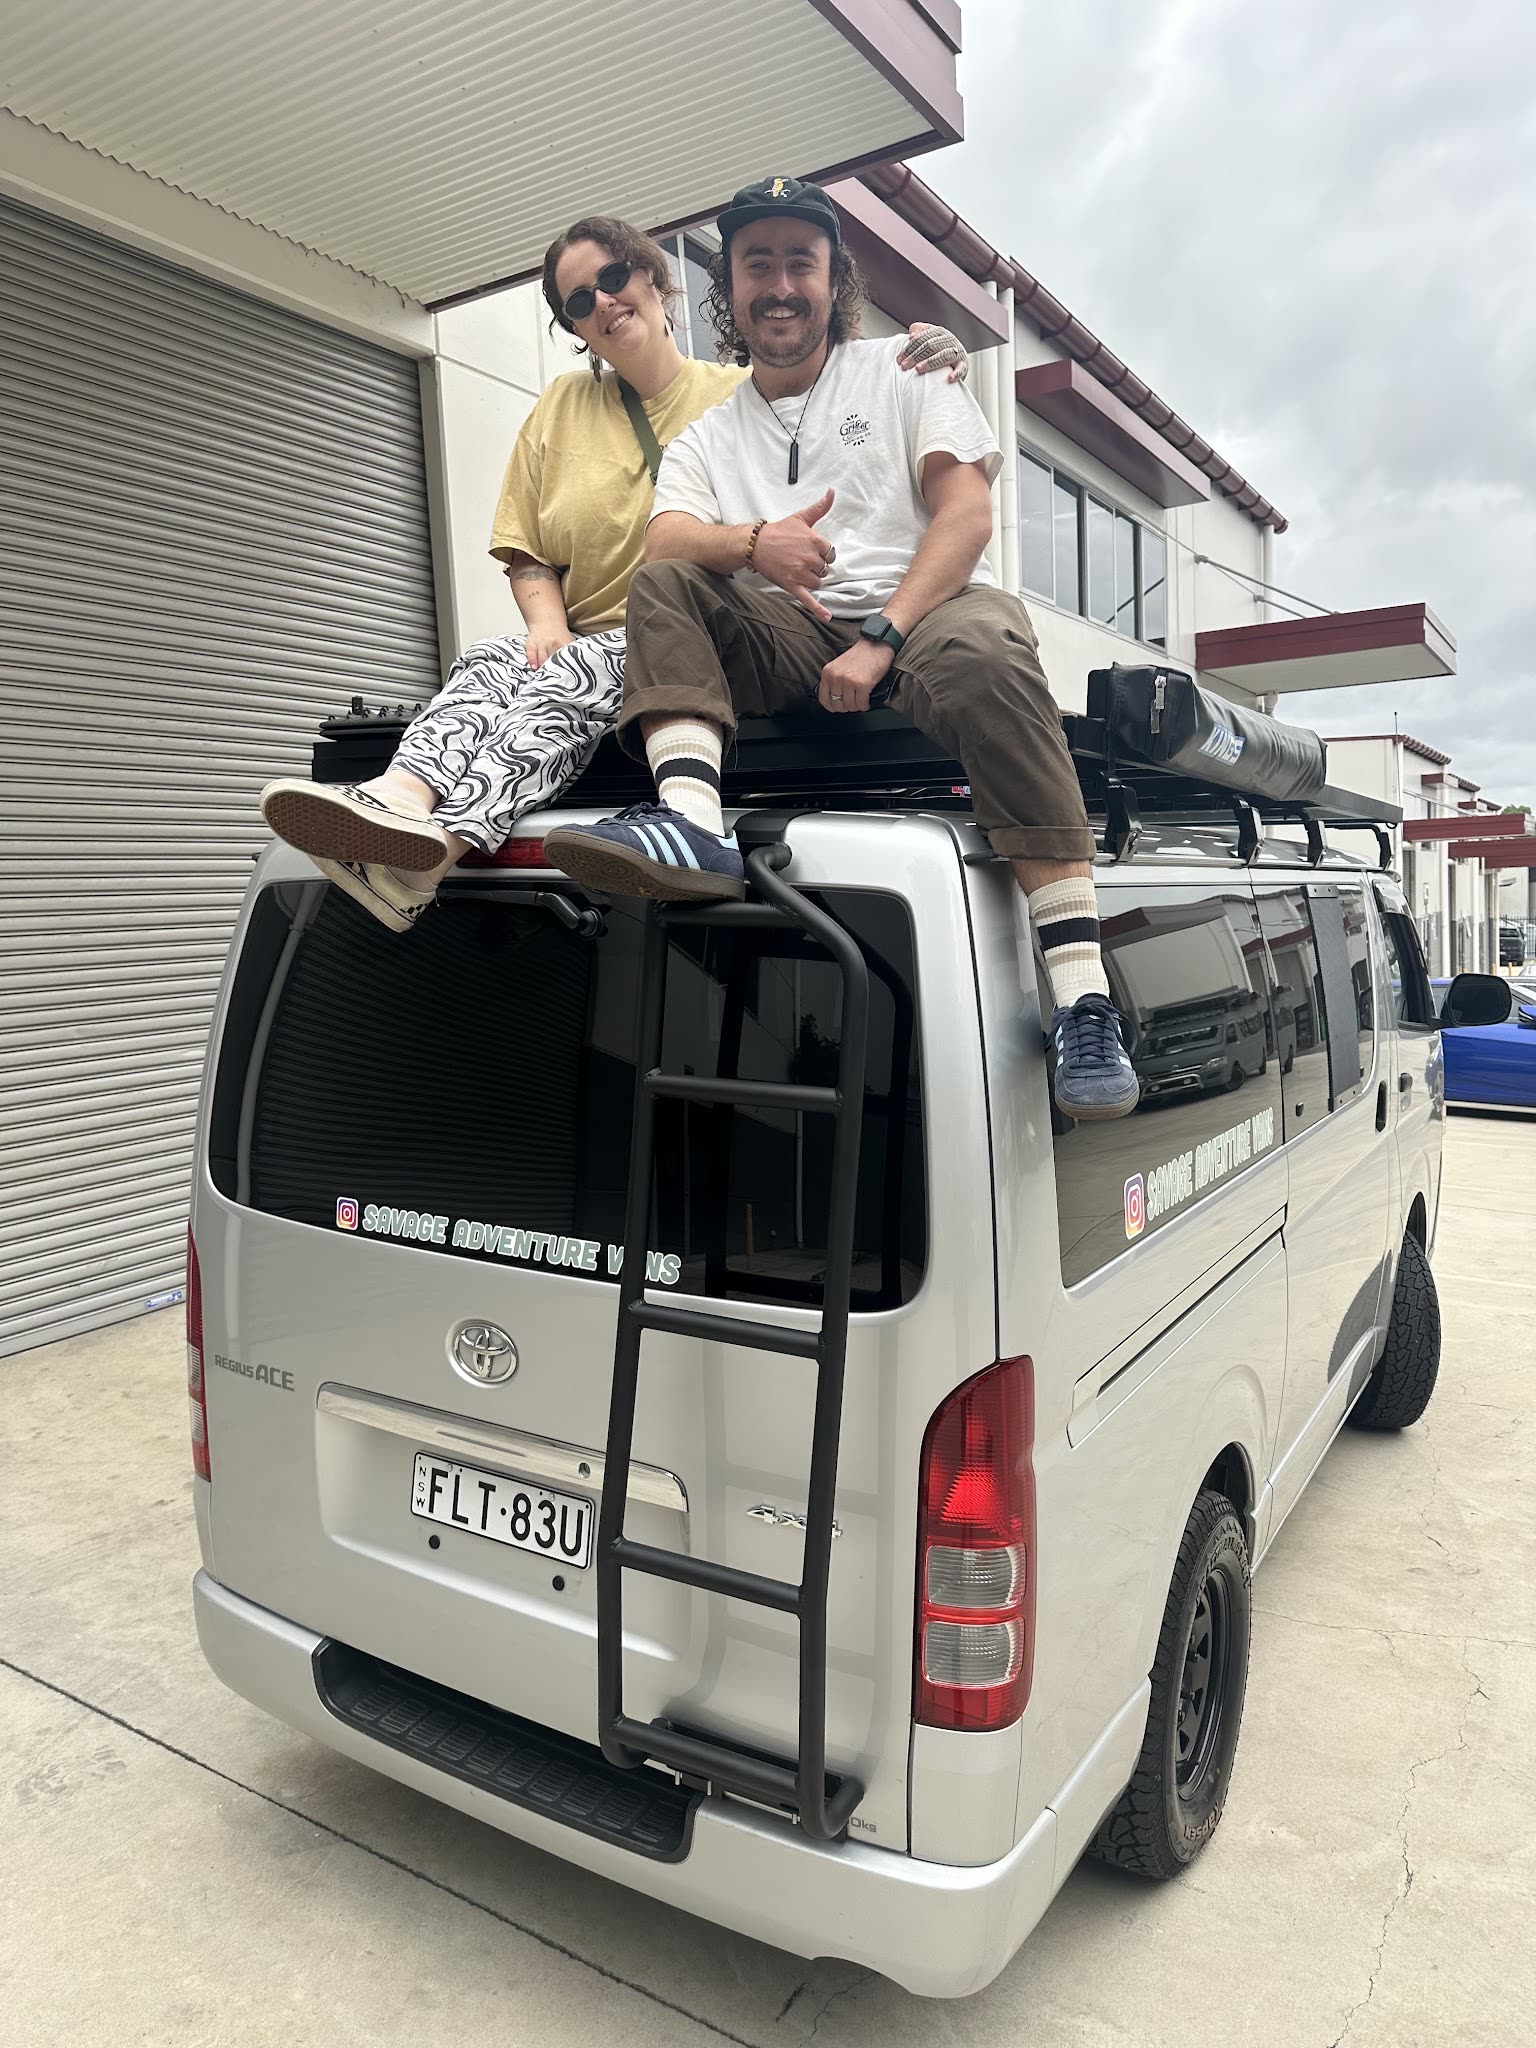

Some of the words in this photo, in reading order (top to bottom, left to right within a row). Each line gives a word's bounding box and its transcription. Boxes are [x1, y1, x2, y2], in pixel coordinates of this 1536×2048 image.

[1147, 1150, 1193, 1221] SAVAGE
[1195, 1118, 1251, 1191] ADVENTURE
[1252, 1106, 1274, 1154] VANS
[362, 1204, 449, 1244] SAVAGE
[452, 1219, 601, 1270] ADVENTURE
[607, 1243, 682, 1285] VNS
